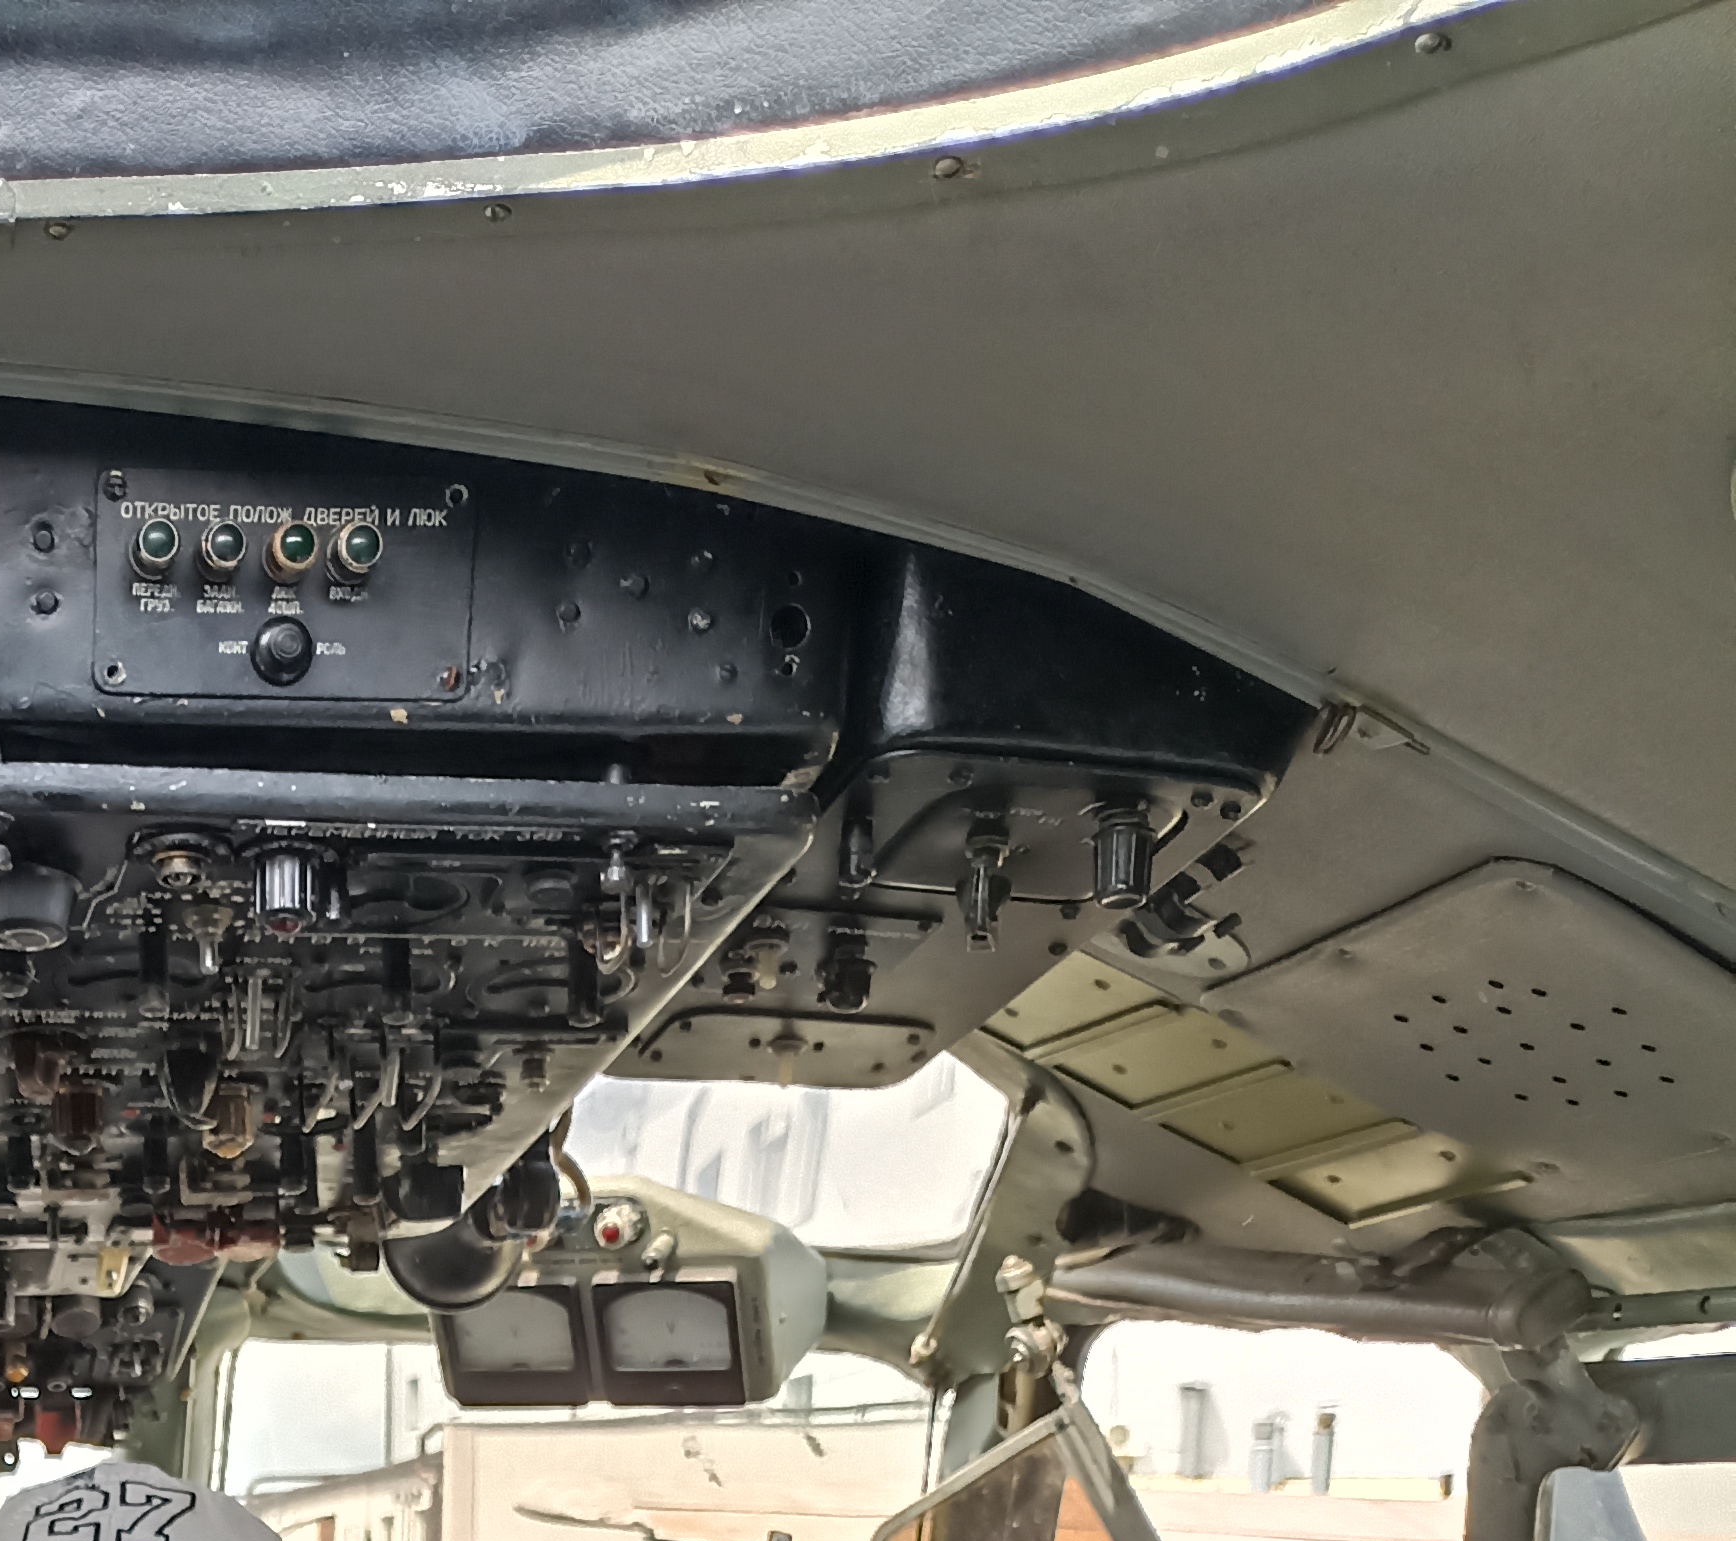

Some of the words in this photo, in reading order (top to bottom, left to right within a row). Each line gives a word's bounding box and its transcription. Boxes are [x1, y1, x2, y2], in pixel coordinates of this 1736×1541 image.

[120, 501, 221, 522] ОТКРЫТОЕ
[229, 504, 293, 526] ПОЛОЖ
[303, 504, 380, 527] ДВЕРЕЙ
[385, 507, 402, 527] И
[407, 508, 448, 528] ЛЮК
